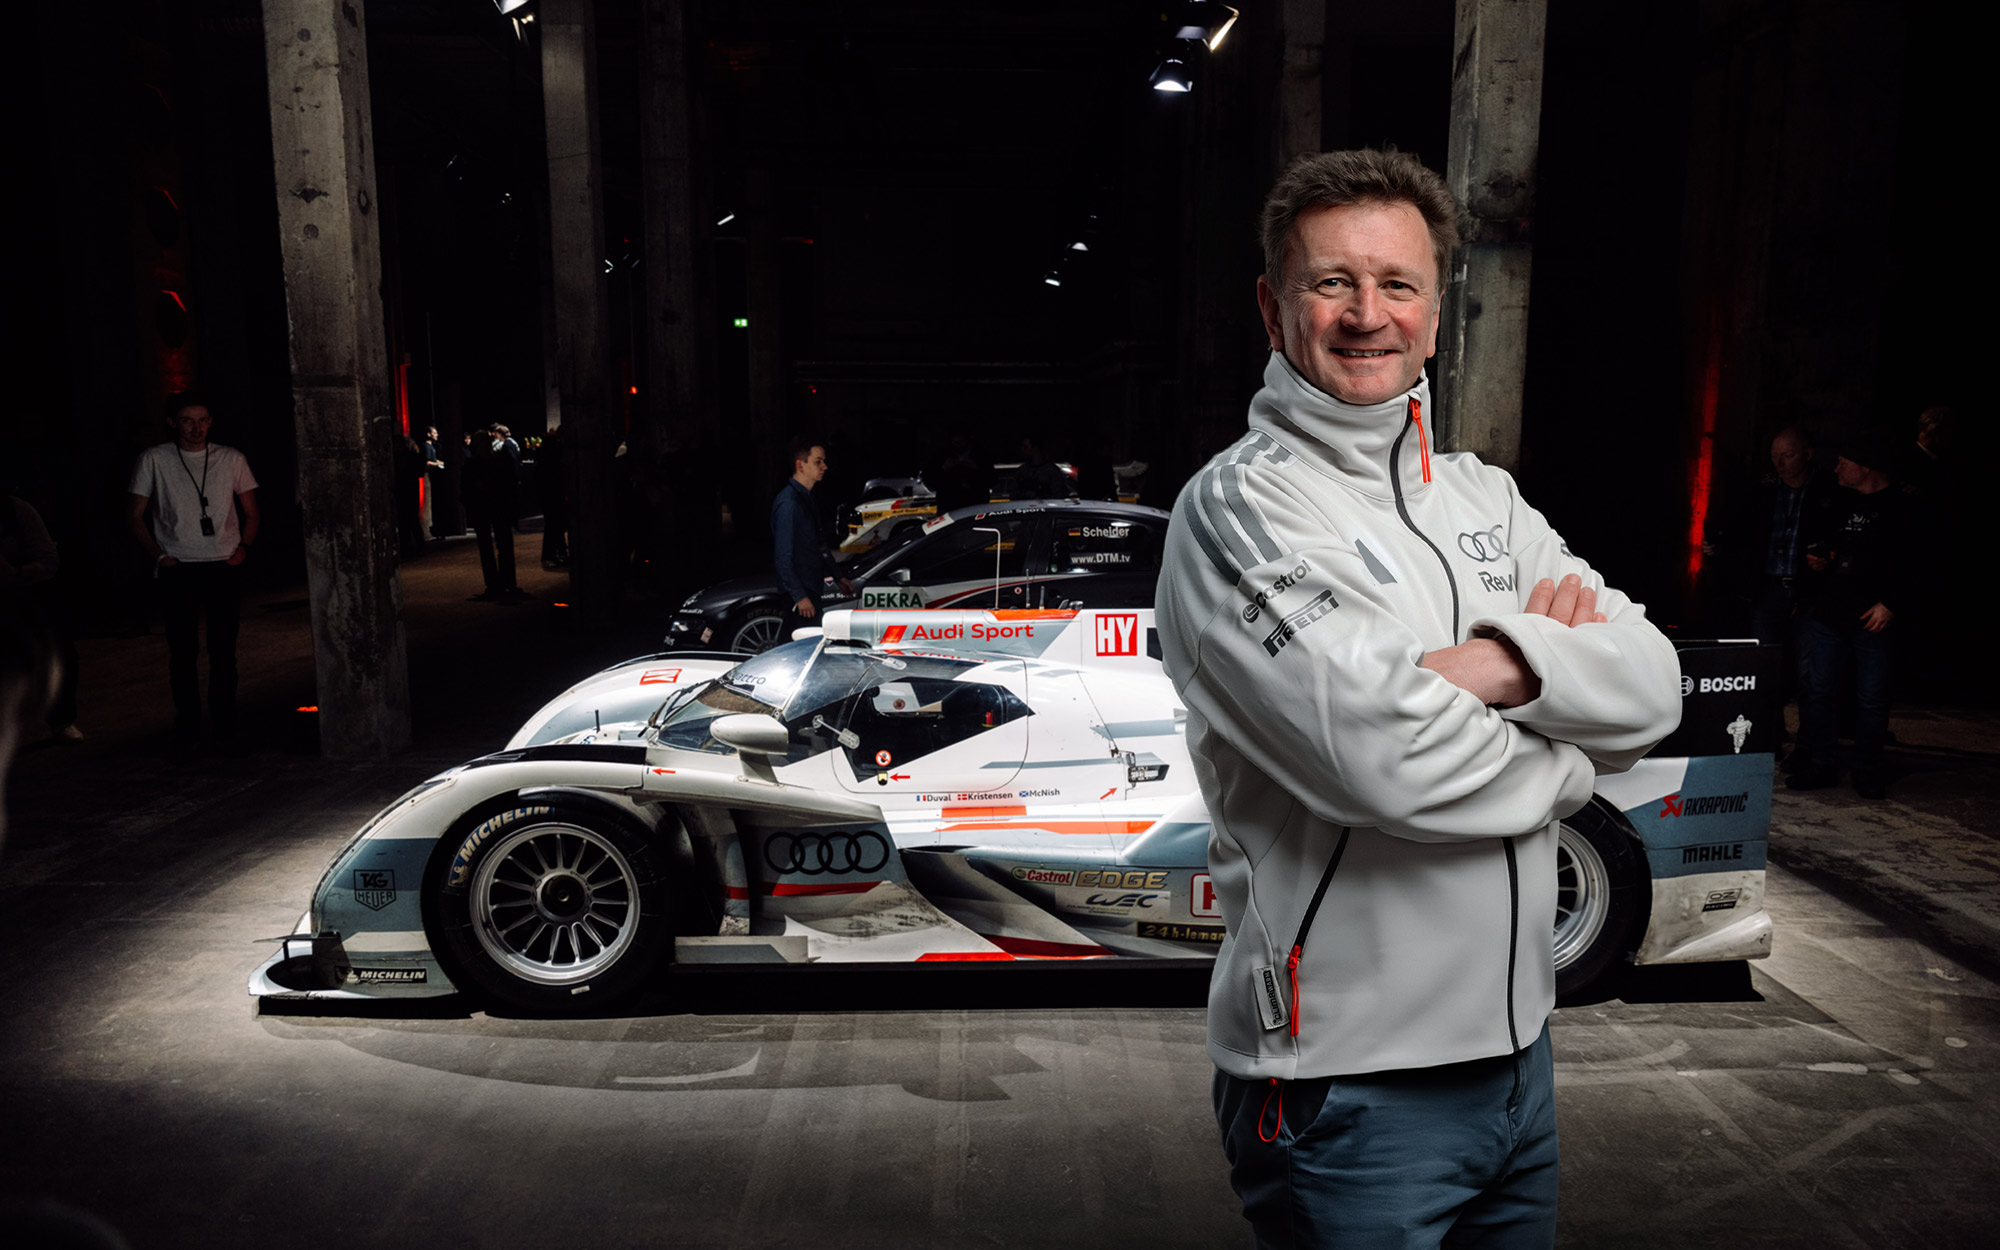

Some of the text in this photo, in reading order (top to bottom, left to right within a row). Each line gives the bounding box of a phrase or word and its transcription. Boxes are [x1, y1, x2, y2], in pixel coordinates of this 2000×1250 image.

[988, 507, 1046, 517] Audi Sport
[1083, 526, 1130, 538] Scheider
[1071, 553, 1131, 564] www.DTM.tv
[1255, 559, 1312, 610] Castrol
[864, 593, 923, 608] DEKRA
[1262, 589, 1340, 658] PIRELLI
[911, 623, 1035, 642] Audi Sport
[1096, 616, 1136, 654] HY
[1700, 675, 1756, 693] BOSCH
[926, 794, 952, 802] Duval
[967, 792, 1013, 801] Kristensen
[1029, 788, 1061, 797] McNish
[459, 805, 550, 864] MICHELIN
[1682, 844, 1743, 864] MAHLE
[360, 872, 388, 888] TAG
[1027, 869, 1170, 889] Castrol EDGE
[357, 891, 393, 908] HEUER
[1086, 893, 1158, 908] WEC
[360, 970, 426, 980] MICHELIN
